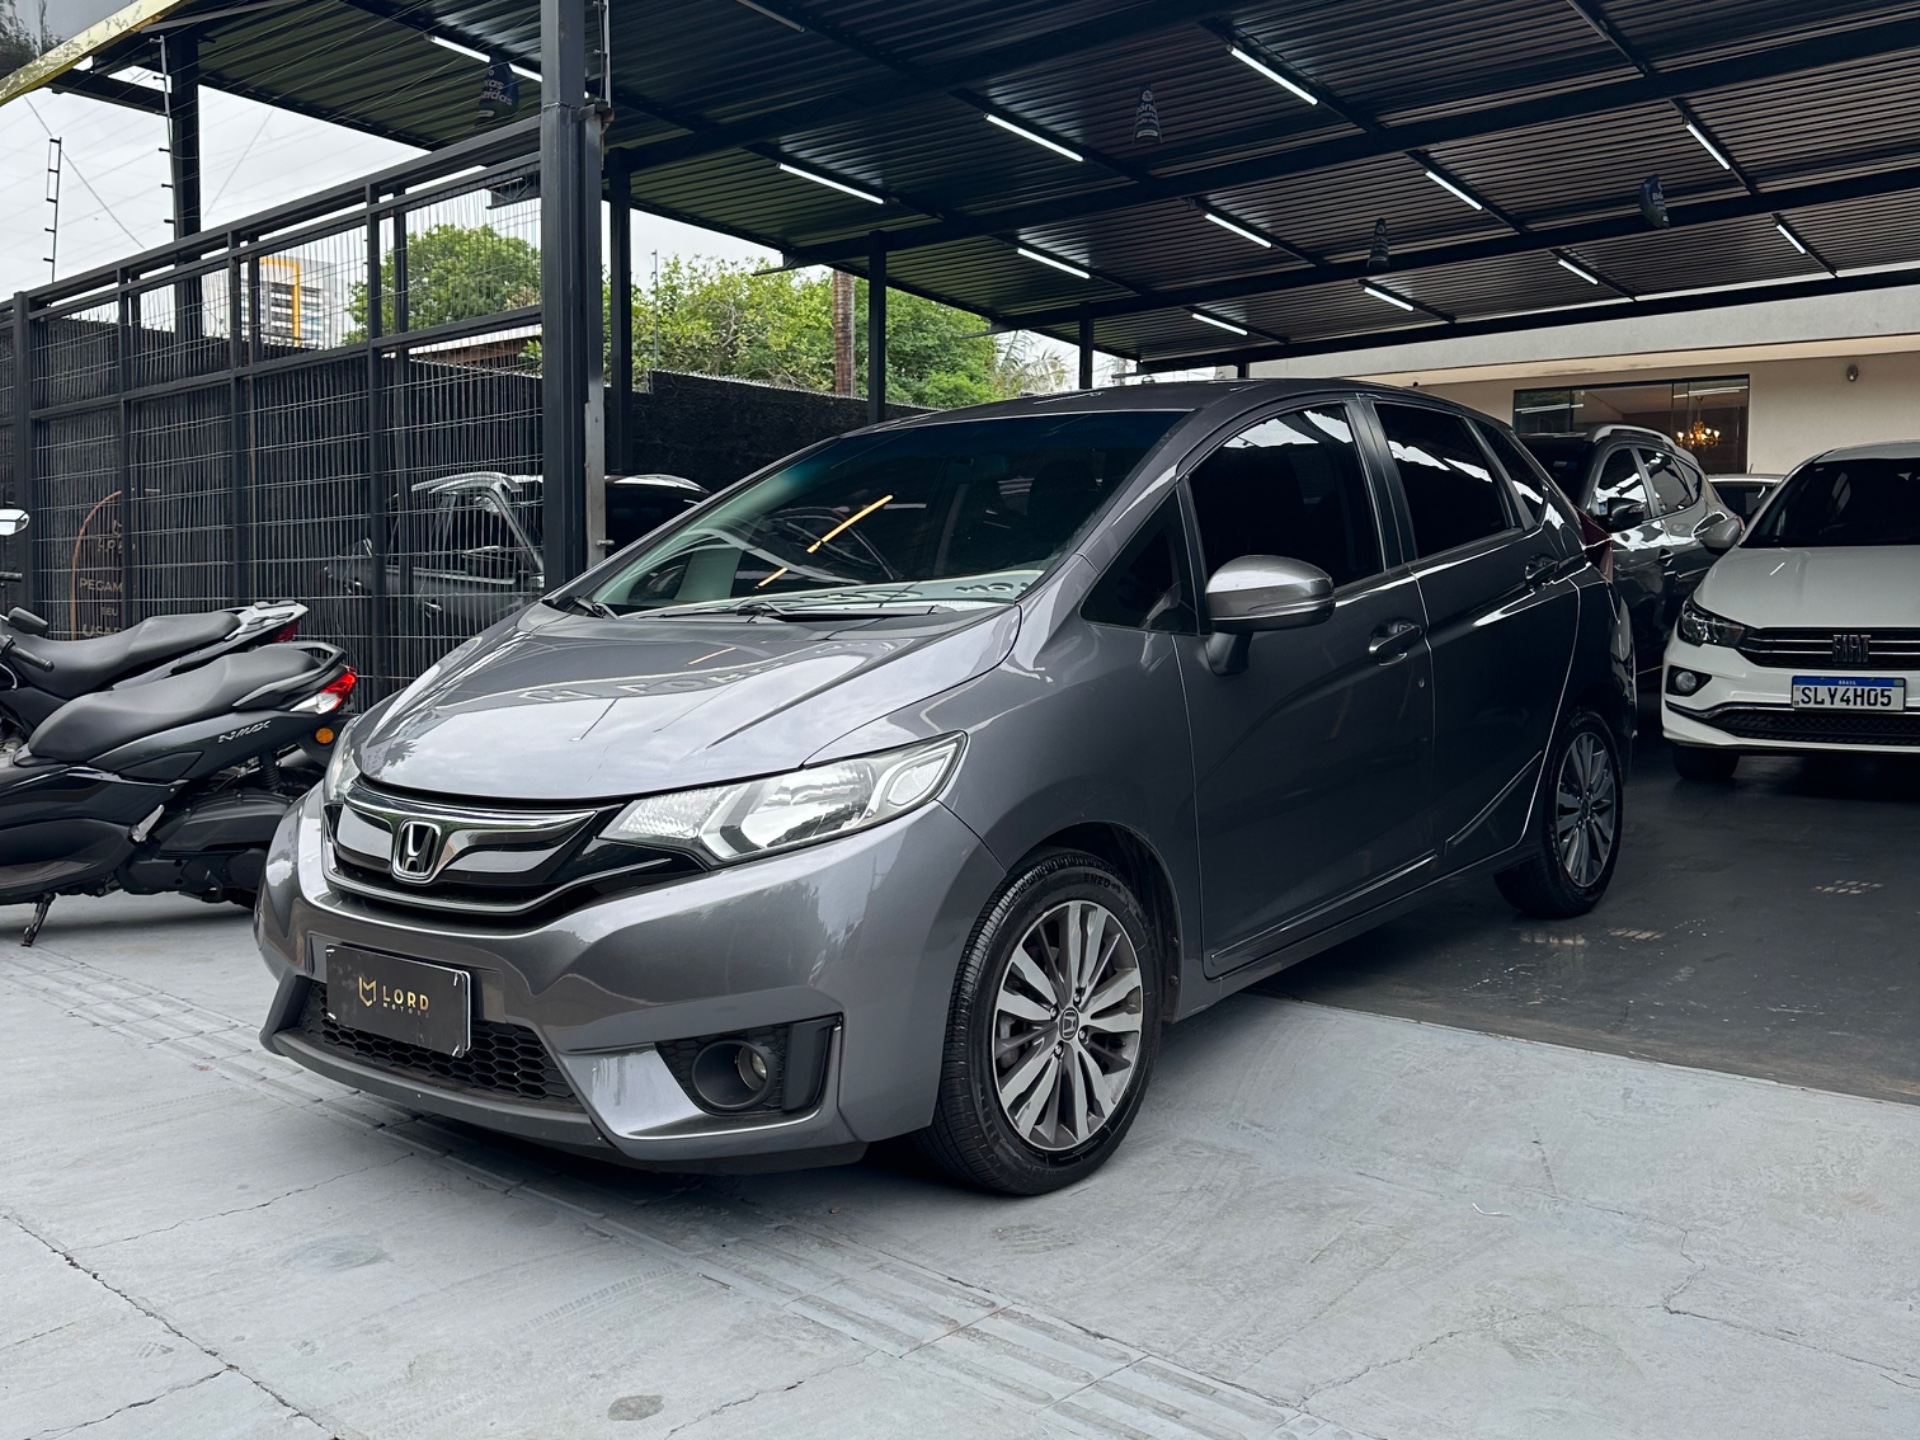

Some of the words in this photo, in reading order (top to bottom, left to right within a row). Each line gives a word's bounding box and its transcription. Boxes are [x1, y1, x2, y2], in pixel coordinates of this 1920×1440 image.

[79, 577, 136, 593] PEGAM
[1832, 634, 1871, 662] FIAT
[1801, 687, 1892, 707] SLY4H05
[218, 720, 271, 743] NMAX
[382, 985, 429, 1011] LORD
